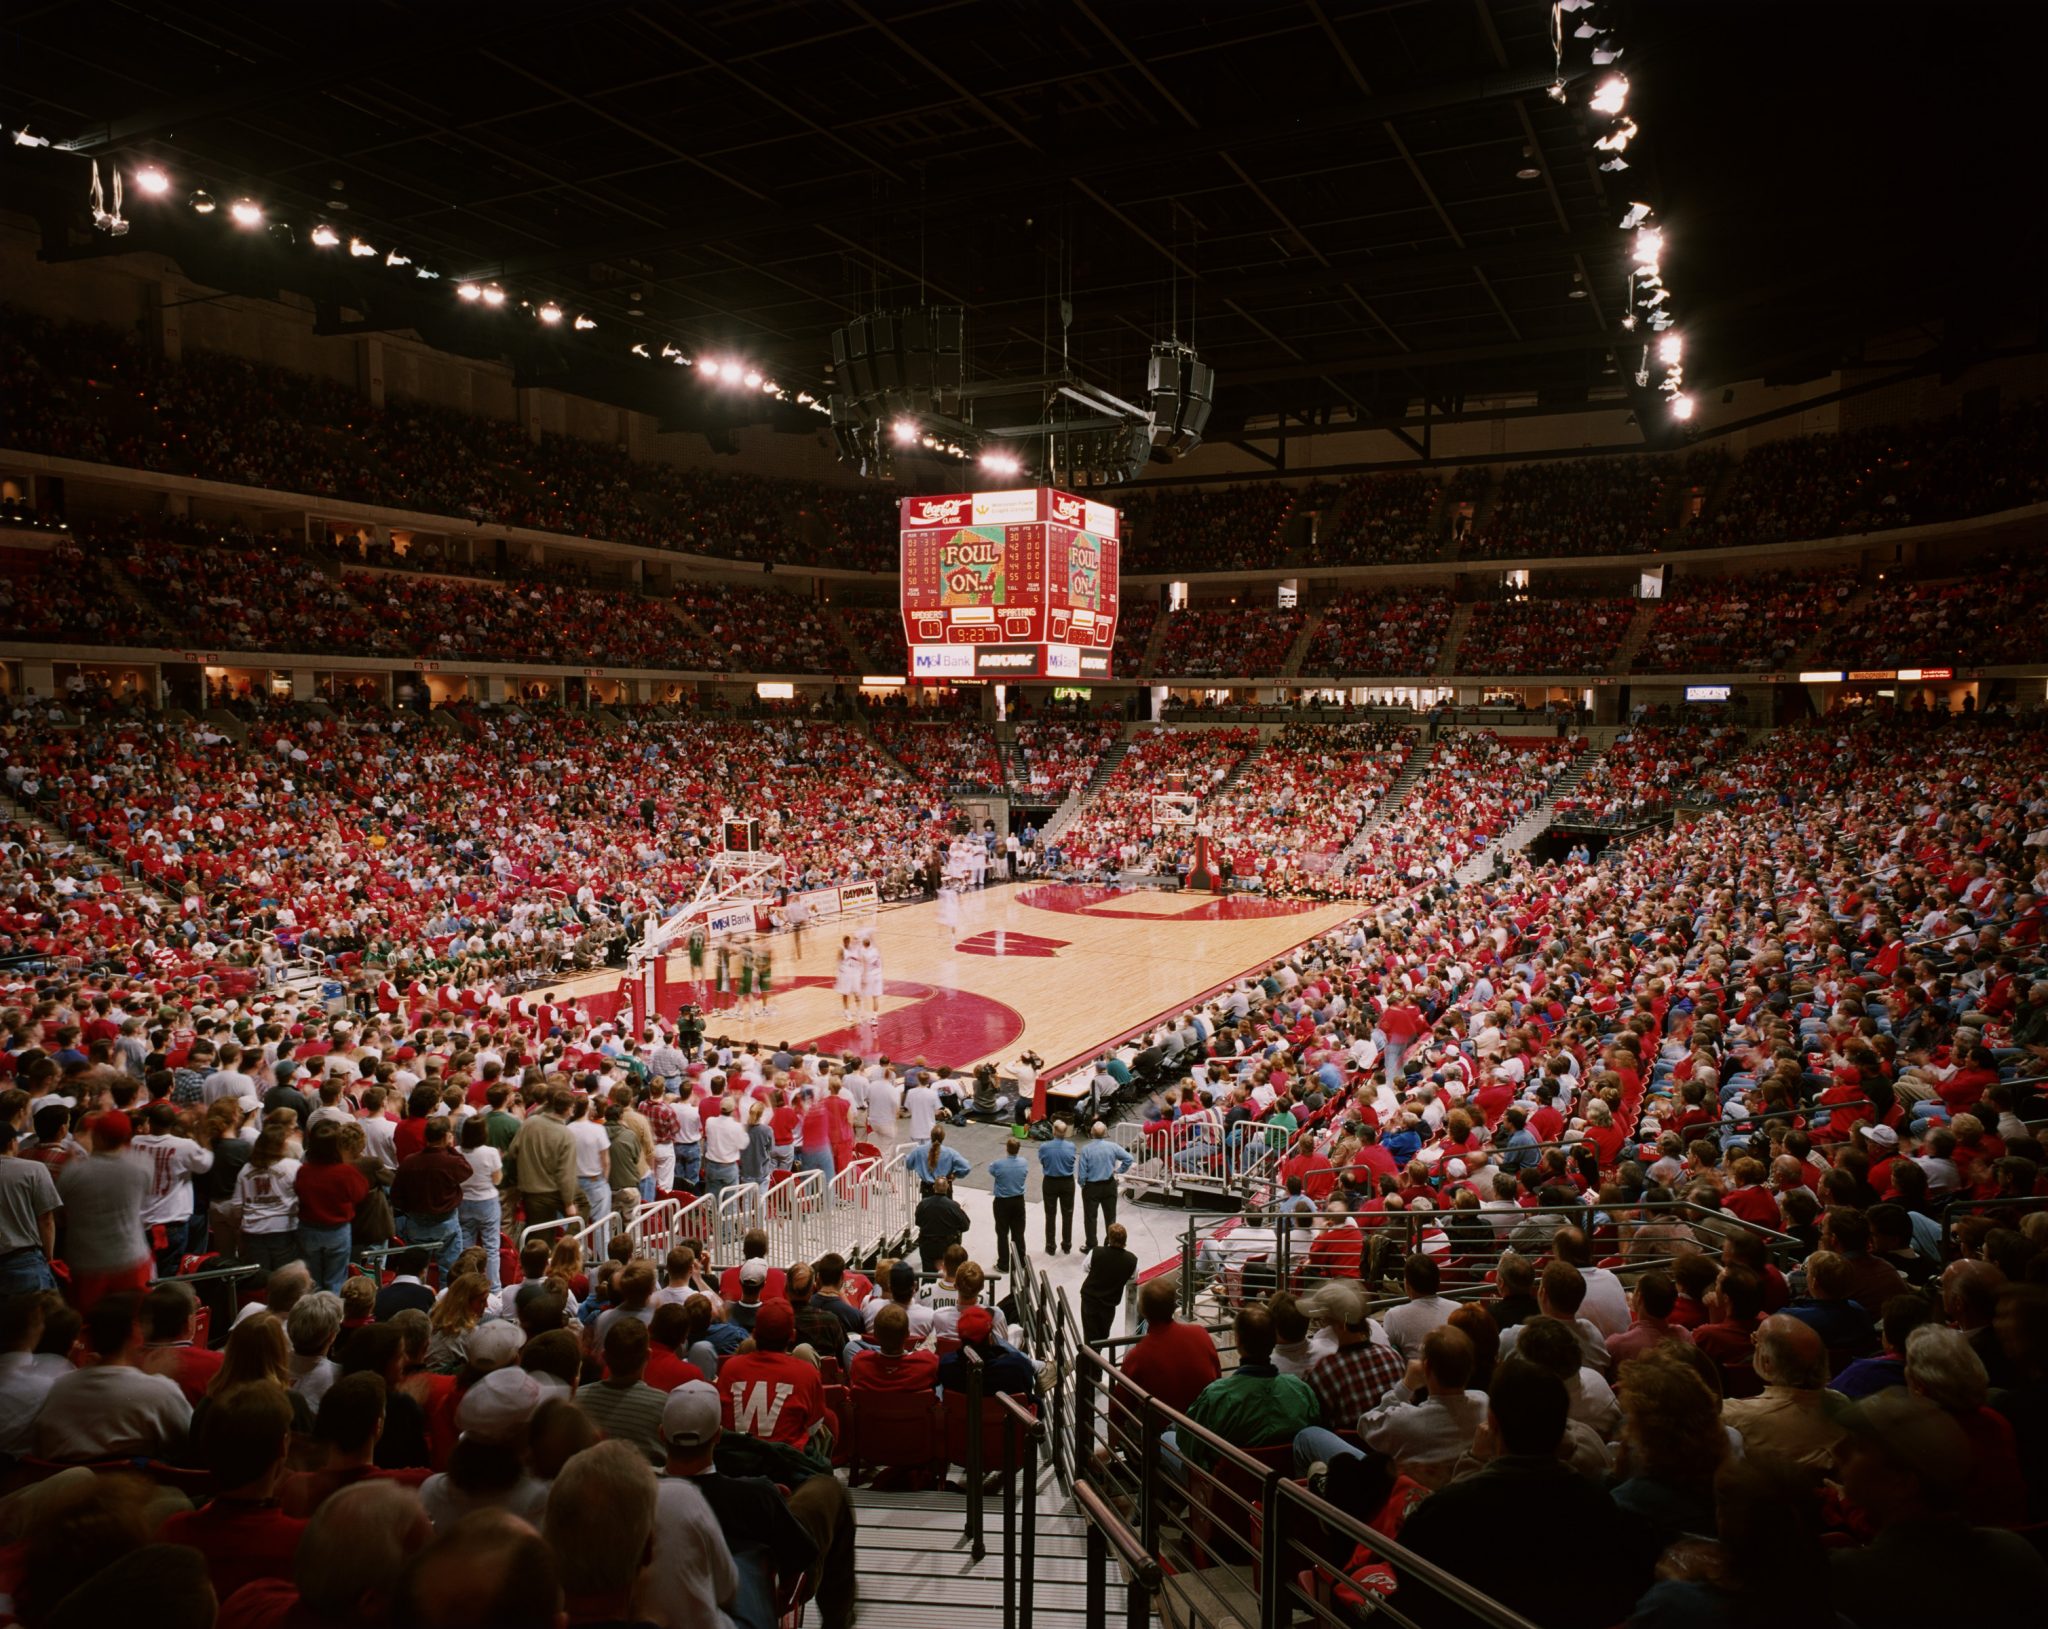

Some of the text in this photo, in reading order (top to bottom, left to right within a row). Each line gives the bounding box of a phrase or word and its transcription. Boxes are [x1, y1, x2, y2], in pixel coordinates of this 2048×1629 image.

[946, 545, 999, 564] FOUL
[1072, 548, 1098, 569] FOUL
[997, 608, 1036, 618] SPARTANS
[958, 628, 985, 642] 9:23
[944, 655, 971, 666] Bank
[842, 886, 873, 900] RAYOVAC
[731, 912, 751, 926] Bank
[730, 1381, 794, 1437] W
